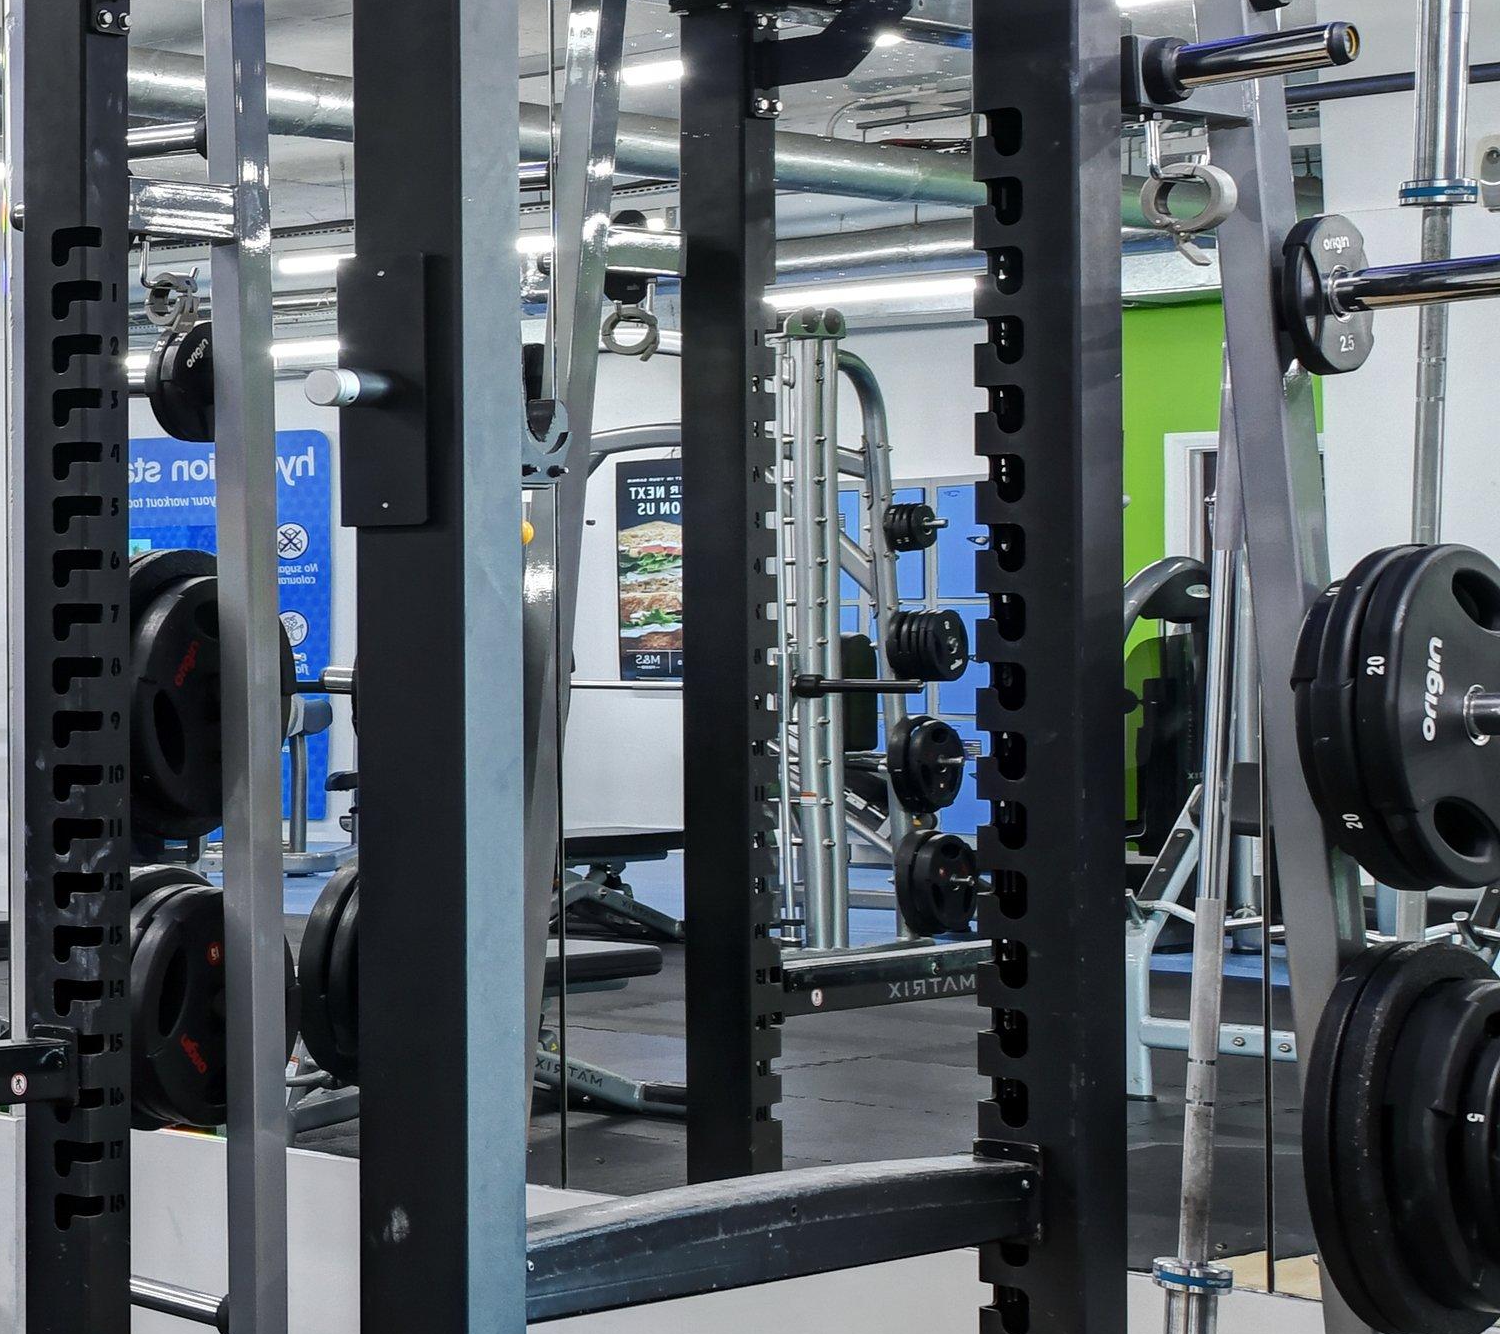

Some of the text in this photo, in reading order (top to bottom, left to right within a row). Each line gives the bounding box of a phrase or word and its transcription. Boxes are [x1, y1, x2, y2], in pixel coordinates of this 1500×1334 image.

[1322, 235, 1350, 254] origin
[1366, 654, 1385, 677] 20
[1421, 636, 1445, 742] origin
[1342, 813, 1364, 830] 20
